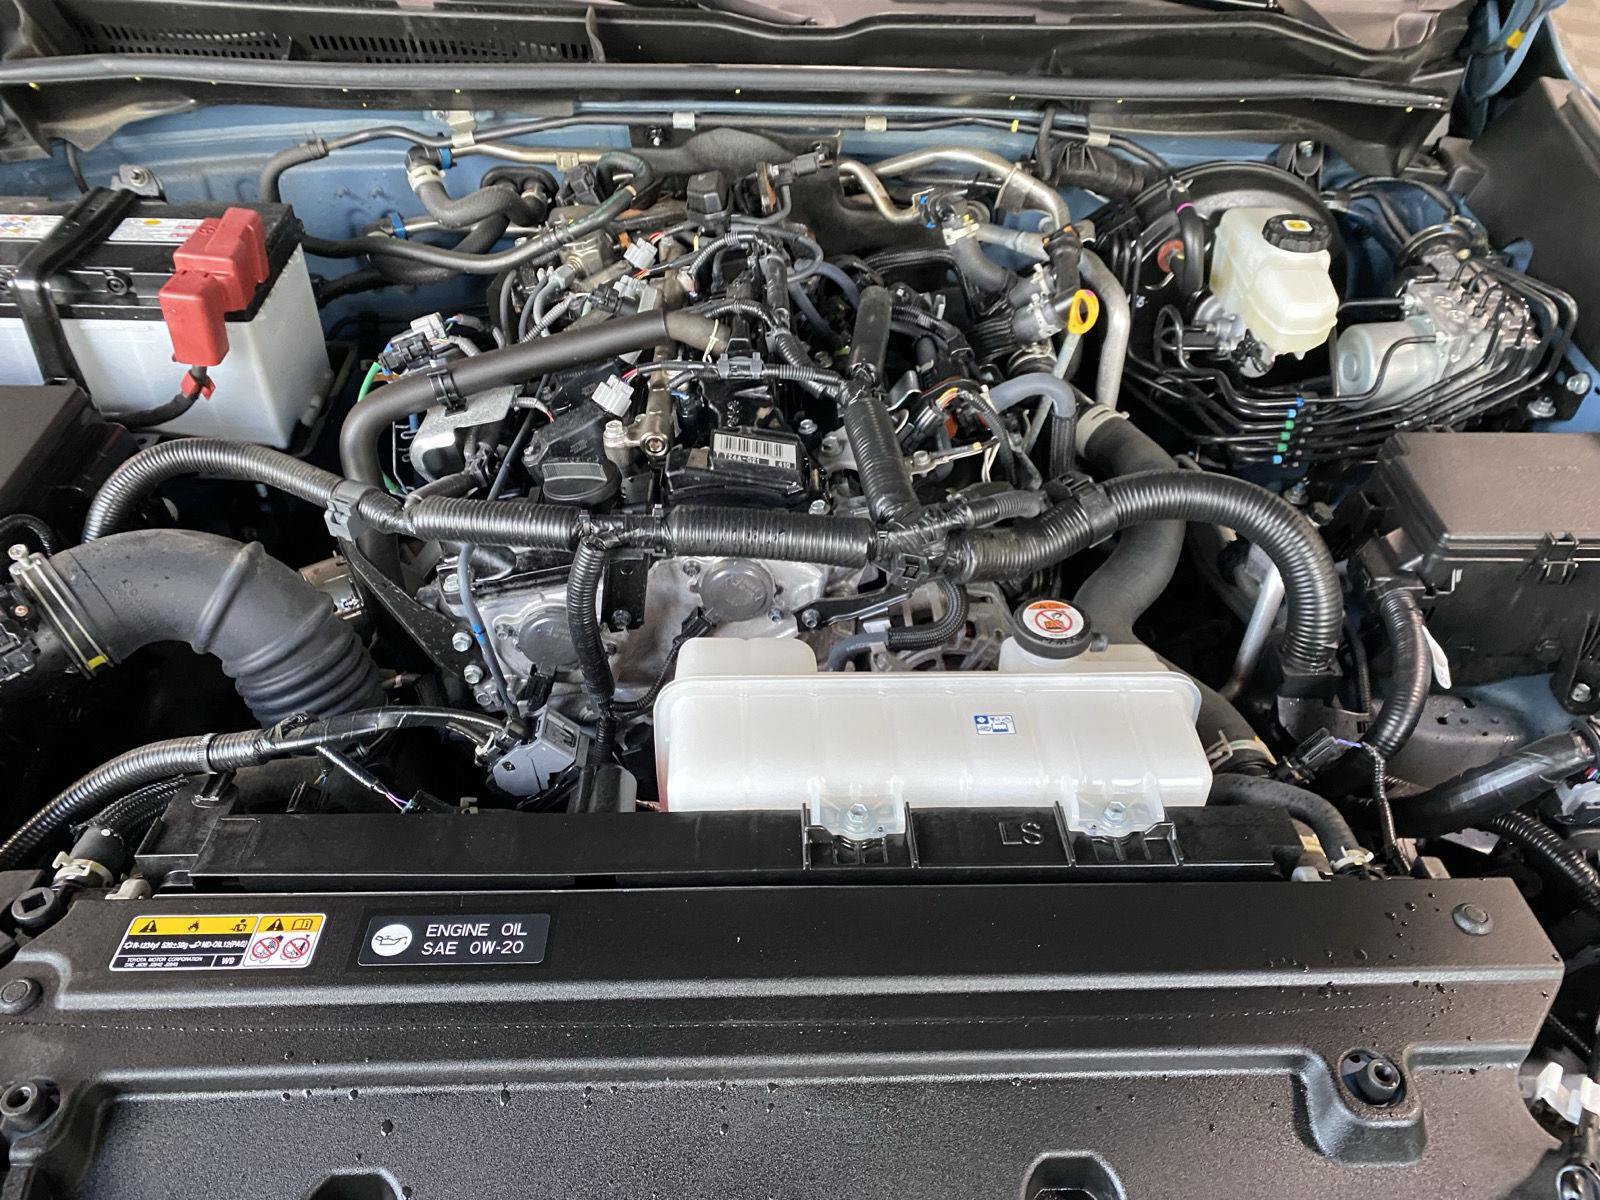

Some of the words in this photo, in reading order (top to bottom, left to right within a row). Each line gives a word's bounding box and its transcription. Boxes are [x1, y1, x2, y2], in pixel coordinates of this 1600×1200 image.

[998, 821, 1045, 845] LS
[425, 923, 490, 938] ENGINE
[501, 923, 528, 936] OIL
[421, 941, 459, 956] SAE
[469, 940, 525, 955] 0W-20
[221, 956, 236, 965] W9
